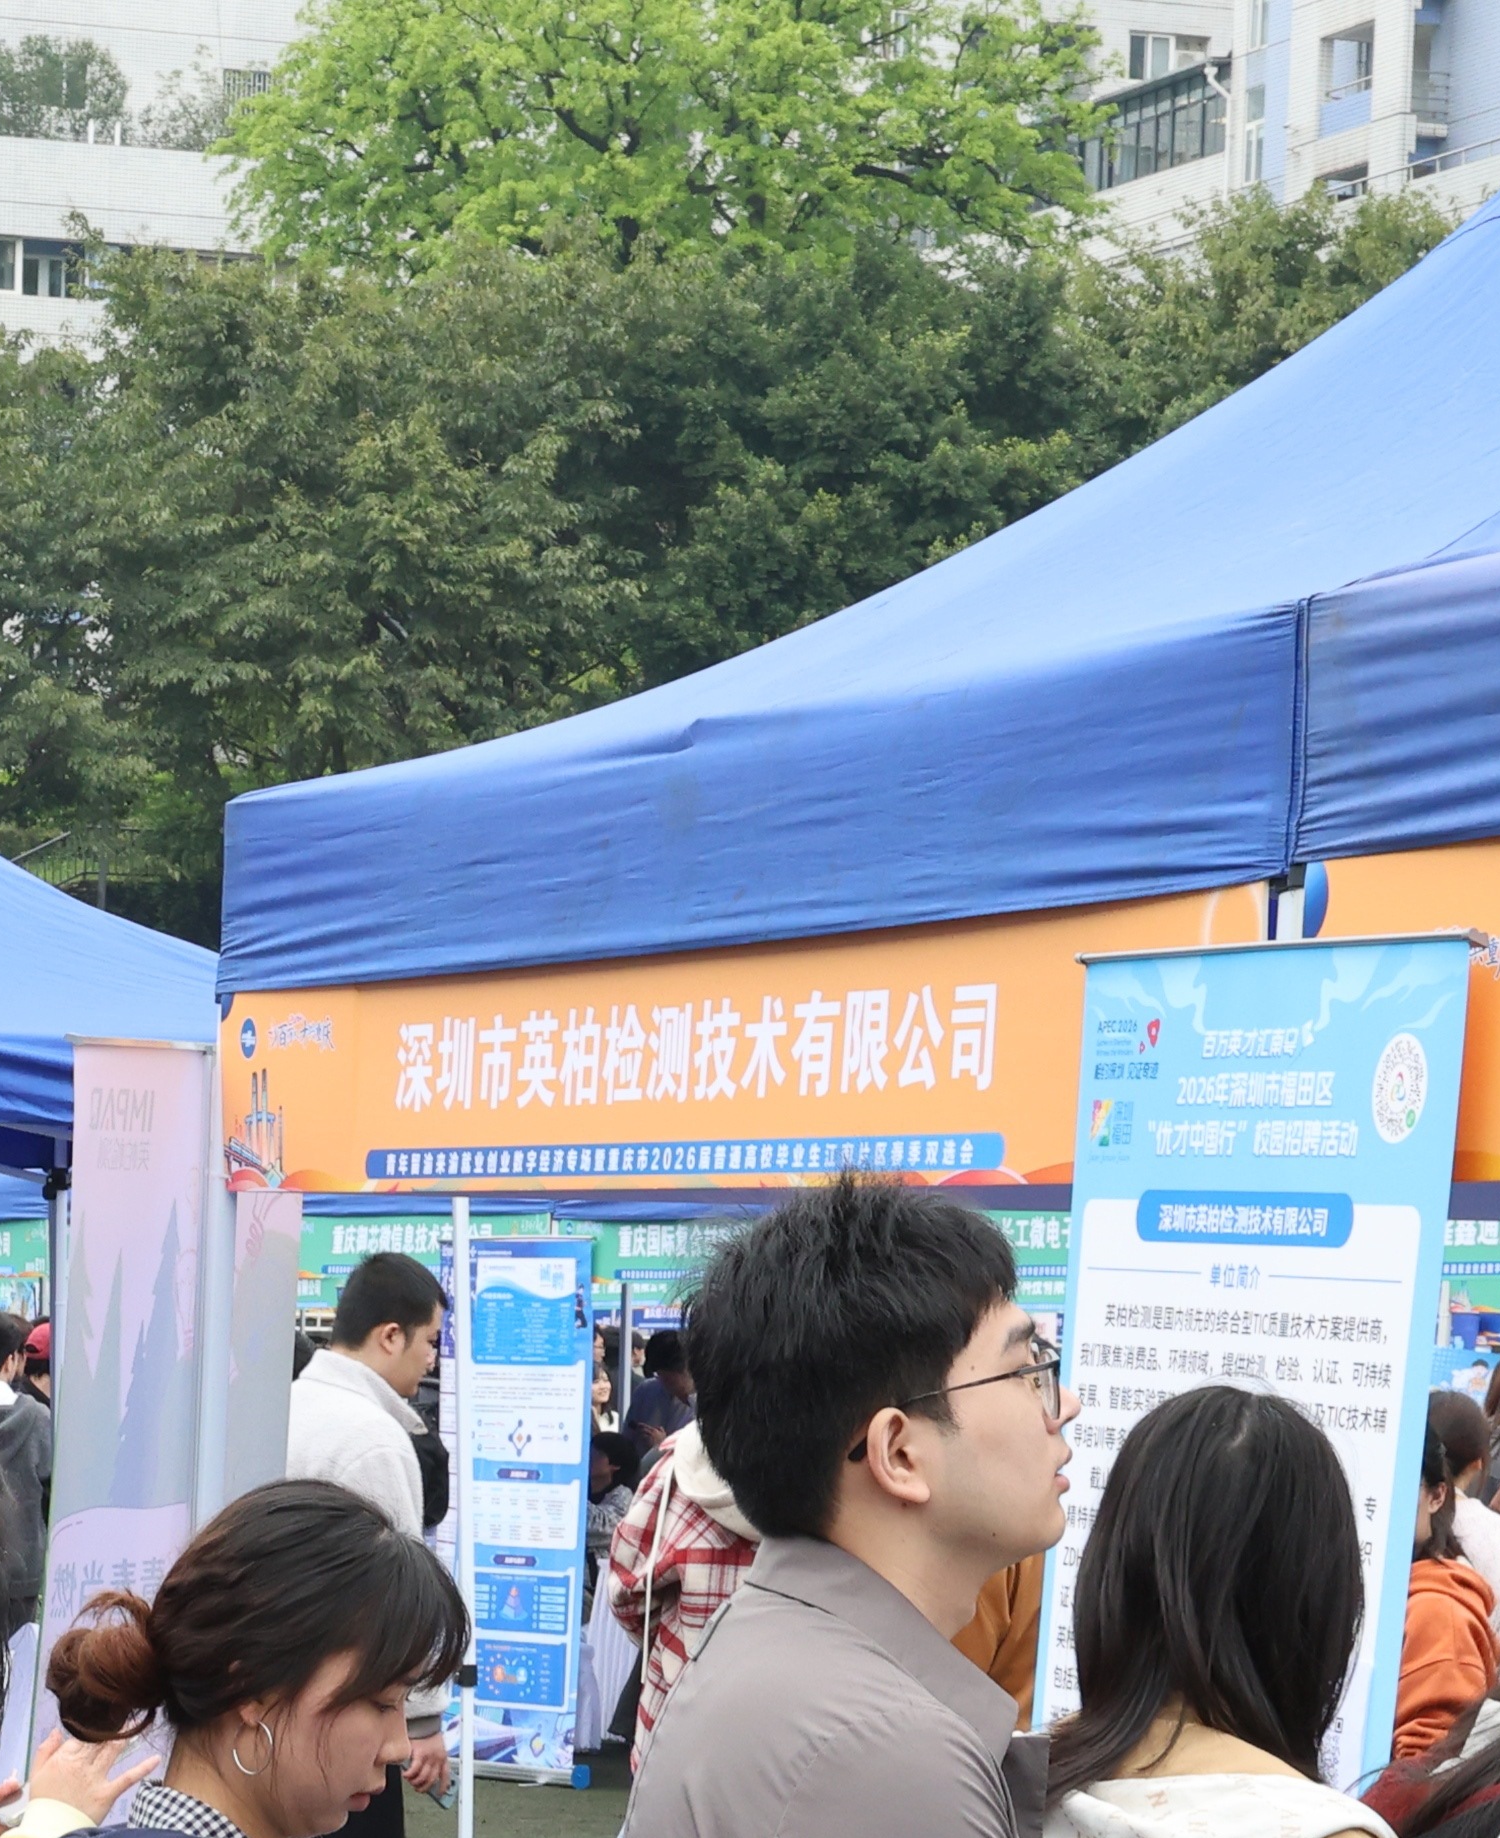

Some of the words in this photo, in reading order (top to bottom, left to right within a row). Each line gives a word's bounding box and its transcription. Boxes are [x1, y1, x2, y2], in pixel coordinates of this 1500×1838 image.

[395, 983, 998, 1112] 深圳市英柏检测技术有限公司
[1176, 1071, 1335, 1108] 2026年深圳市福田区
[1158, 1203, 1328, 1237] 深圳市英柏检测技术有限公司
[1209, 1263, 1261, 1290] 单位简介
